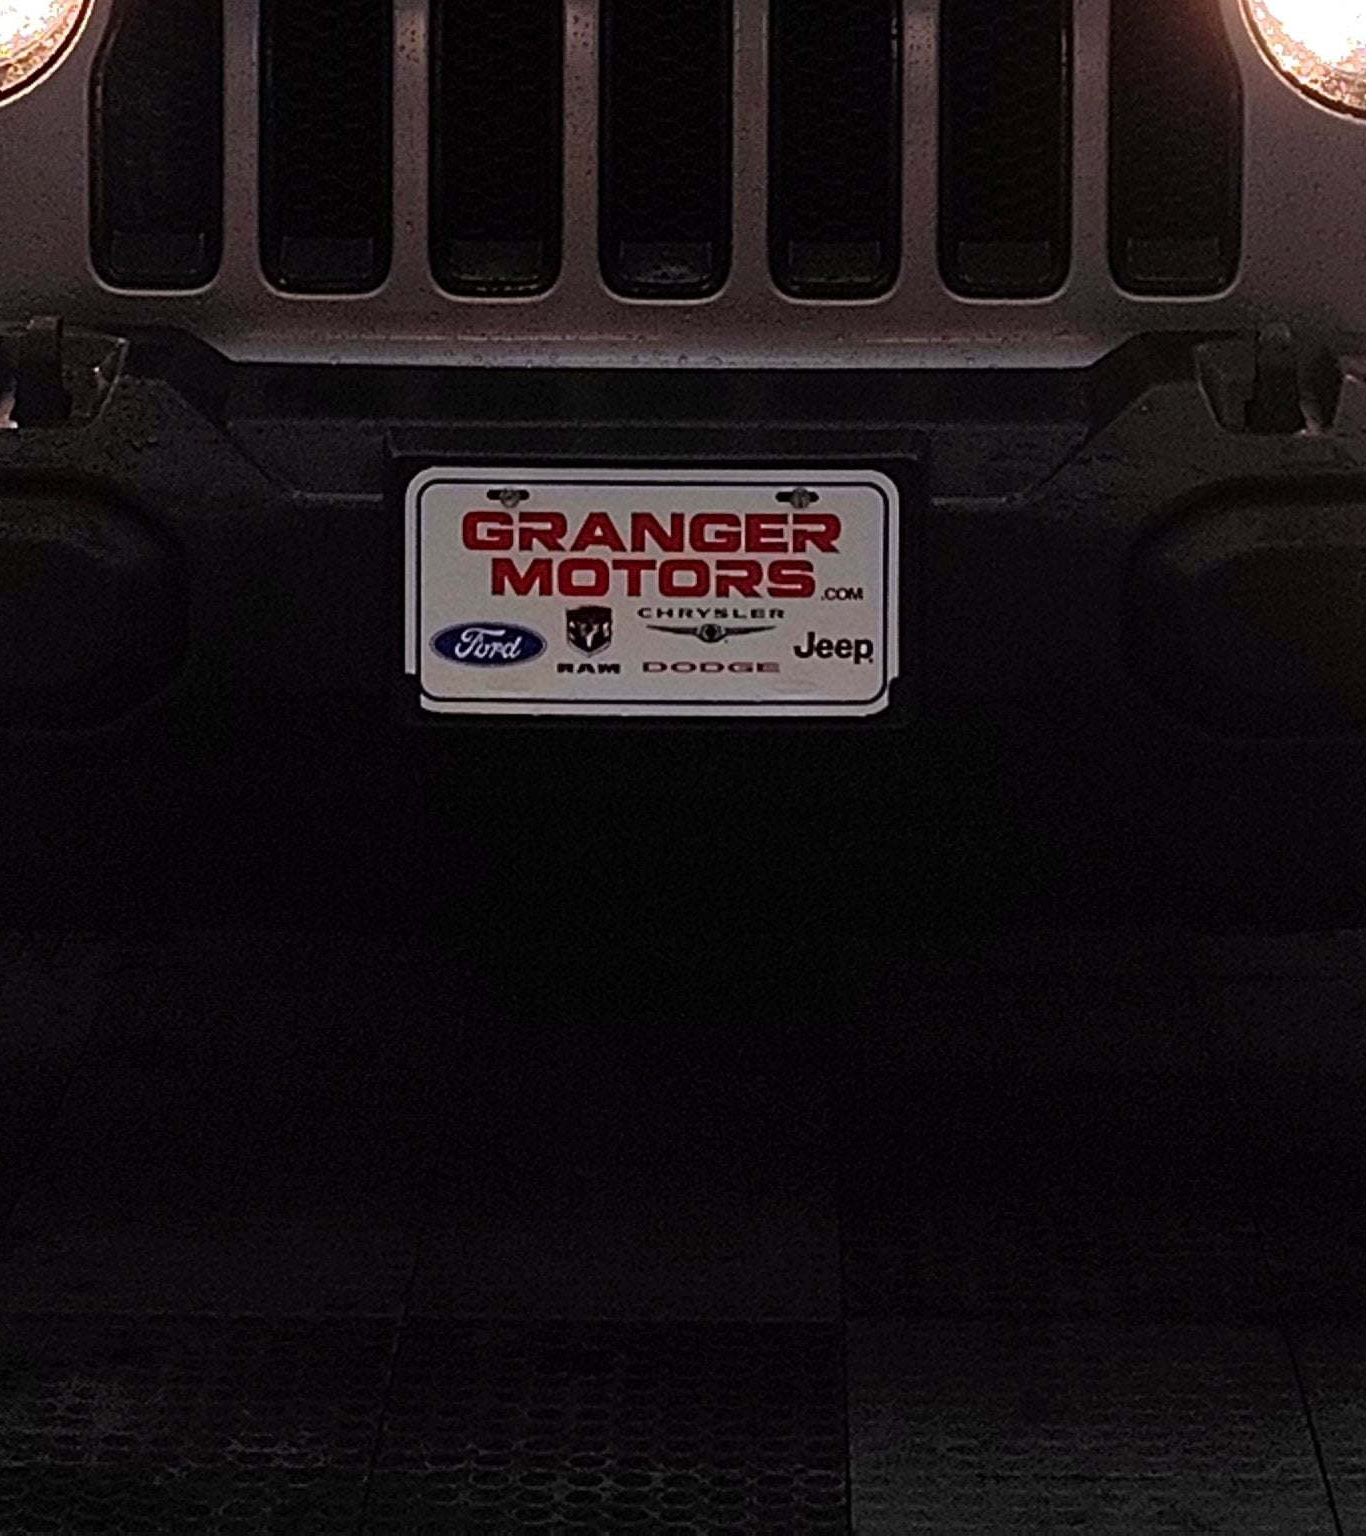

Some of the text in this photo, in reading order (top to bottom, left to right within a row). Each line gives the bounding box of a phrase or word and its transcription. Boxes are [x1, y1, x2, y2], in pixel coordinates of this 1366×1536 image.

[462, 511, 842, 554] GRANGER
[491, 557, 816, 600] MOTORS
[637, 607, 785, 619] CHRYSLER
[454, 627, 522, 660] Ford
[794, 632, 874, 664] Jeep
[556, 663, 621, 675] RAM
[642, 661, 780, 673] DODGE
